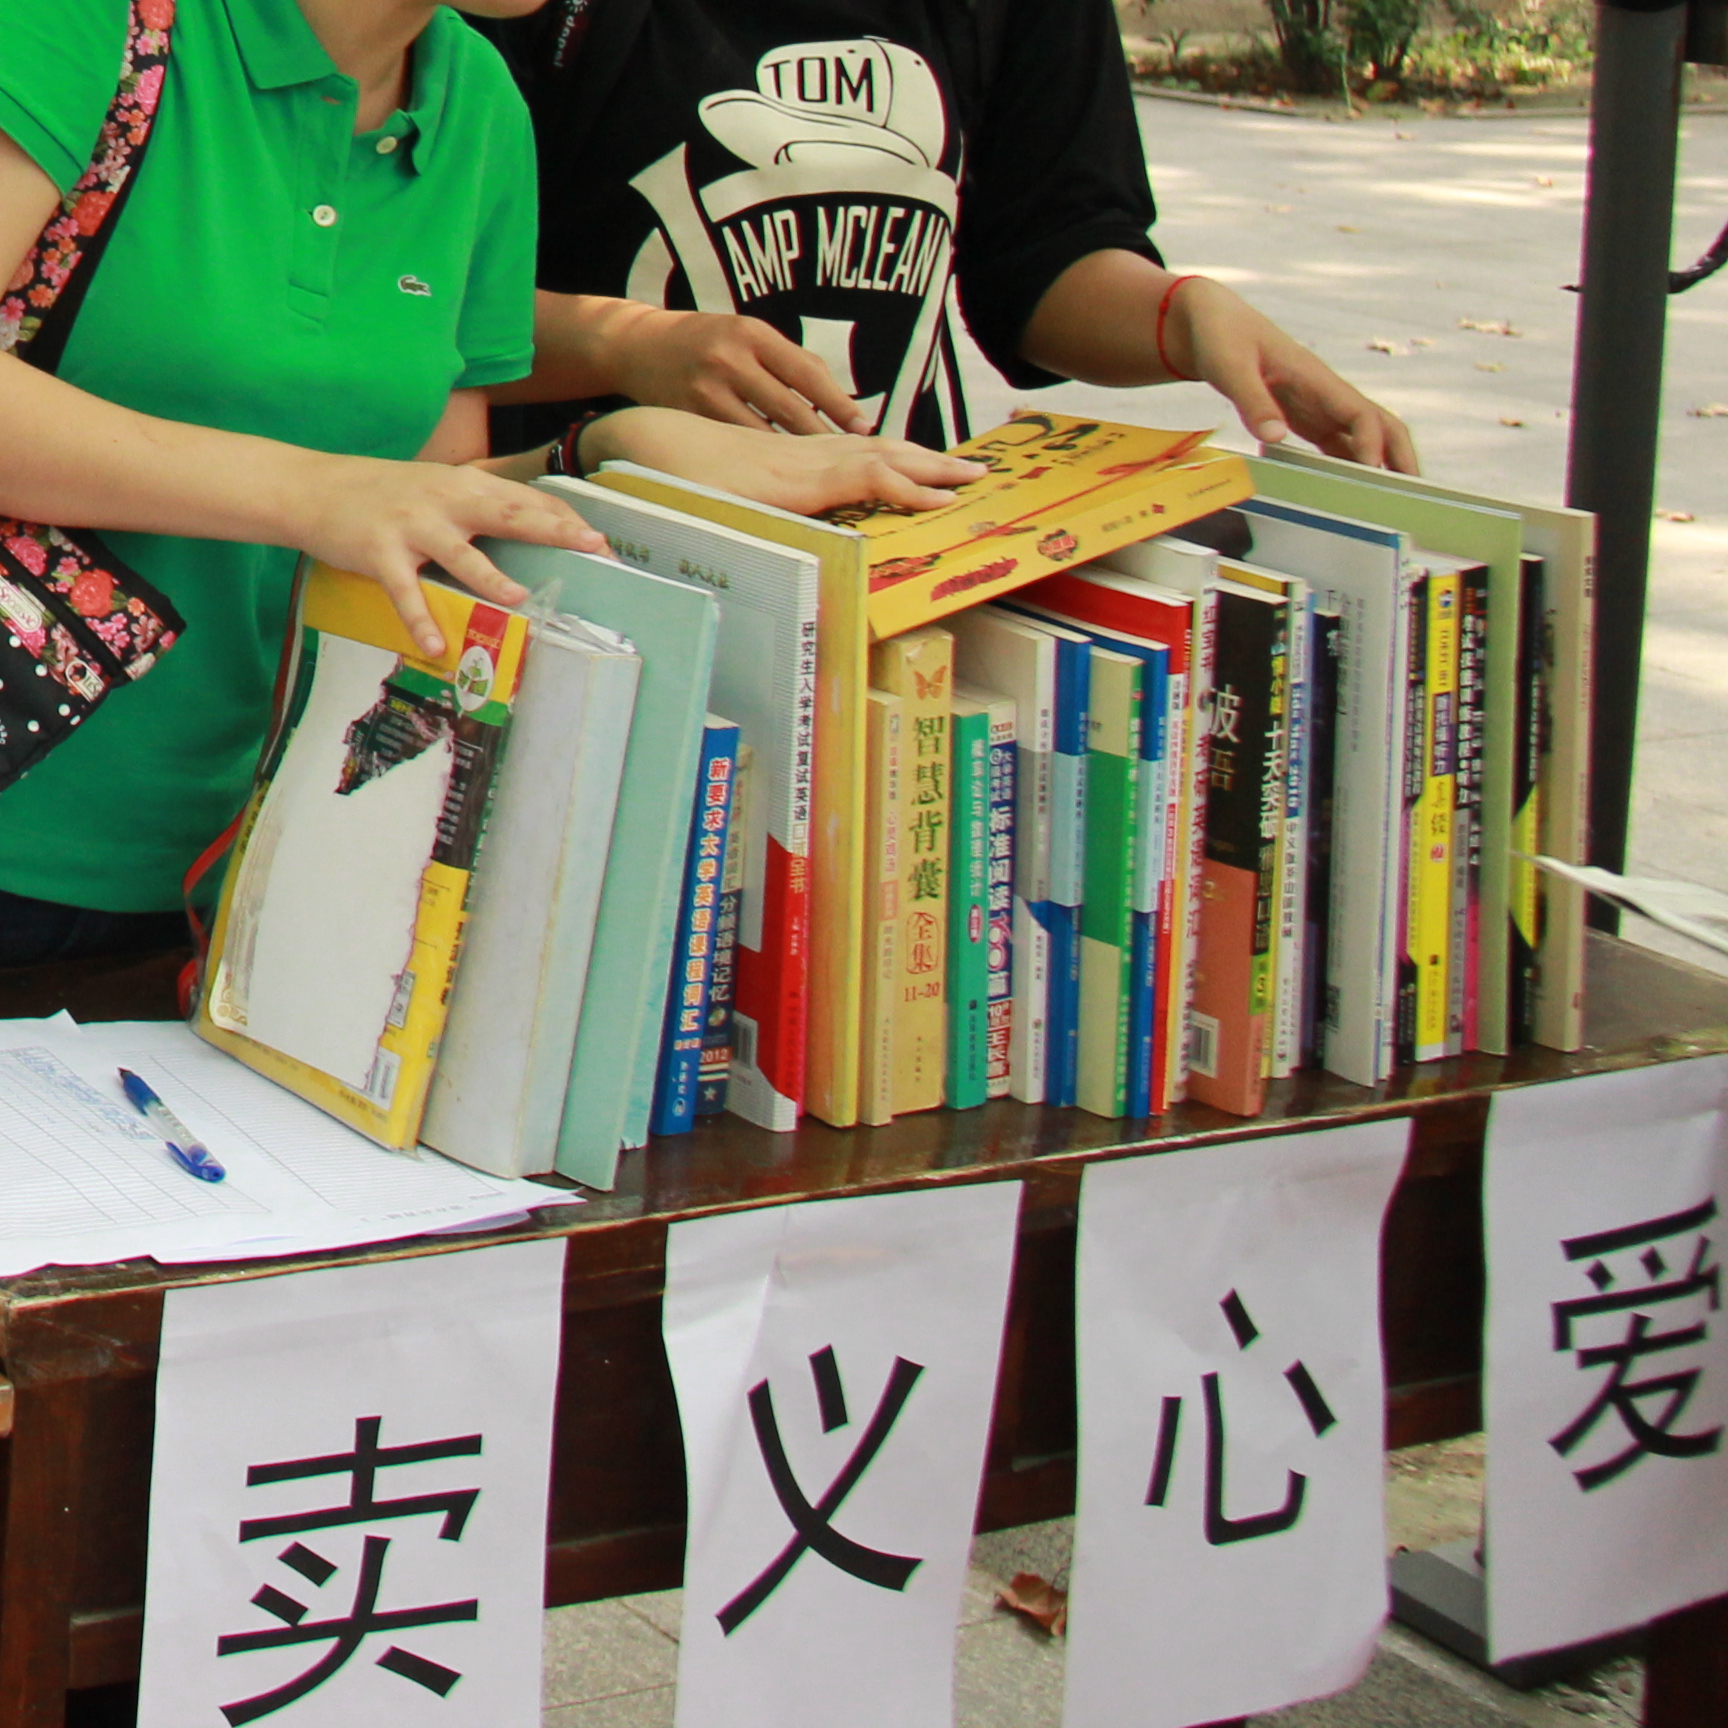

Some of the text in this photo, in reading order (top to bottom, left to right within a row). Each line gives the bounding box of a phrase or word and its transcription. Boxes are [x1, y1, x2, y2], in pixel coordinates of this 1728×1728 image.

[762, 56, 875, 114] TOM
[815, 204, 948, 298] MCLEAN
[908, 714, 944, 903] 智慧背囊
[679, 756, 732, 1033] 新要求大学英语课程词汇
[906, 912, 935, 973] 全集
[215, 1198, 1723, 1728] 卖 义 心 爱
